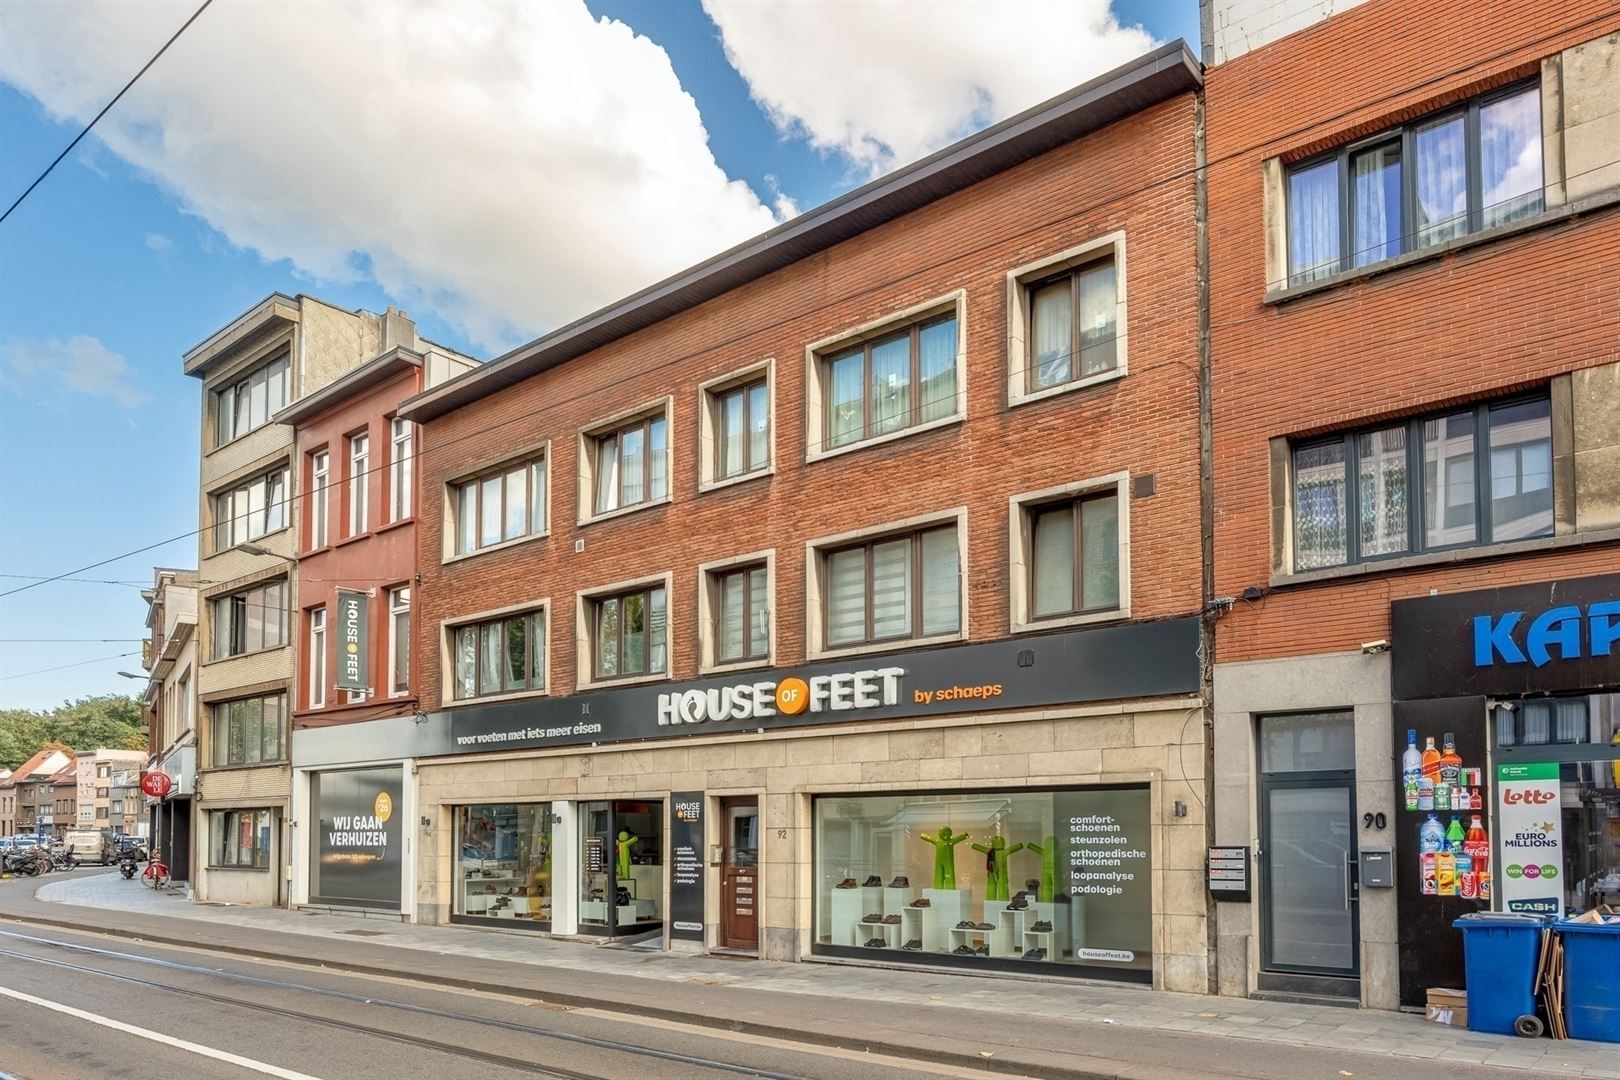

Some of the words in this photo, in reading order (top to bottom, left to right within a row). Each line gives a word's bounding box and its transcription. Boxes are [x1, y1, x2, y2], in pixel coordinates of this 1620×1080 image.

[346, 600, 359, 643] HOUSE
[346, 653, 359, 682] FEET
[658, 681, 777, 726] HOUSE
[781, 689, 798, 703] OF
[809, 667, 905, 713] FEET
[914, 689, 933, 705] by
[935, 683, 1003, 702] schaeps
[457, 734, 477, 745] voor
[477, 731, 508, 744] voeten
[508, 729, 526, 741] met
[527, 727, 546, 739] iets
[546, 726, 573, 738] meer
[573, 722, 602, 735] eisen
[1503, 788, 1556, 805] Lotto
[675, 802, 701, 811] HOUSE
[683, 810, 700, 819] FEET
[1070, 815, 1115, 824] comfort-
[333, 816, 351, 831] WIJ
[352, 815, 383, 831] GAAN
[1363, 812, 1387, 830] 90
[1070, 824, 1120, 832] schoenen
[329, 831, 387, 847] VERHUIZEN
[777, 829, 787, 839] 92
[1515, 832, 1546, 840] EURO
[1070, 835, 1127, 844] steunzolen
[1504, 840, 1558, 848] MILLIONS
[1070, 849, 1146, 859] orthopedische
[1070, 858, 1121, 866] schoenen
[1071, 871, 1134, 881] loopanalyse
[1071, 885, 1123, 895] podologie
[1511, 902, 1556, 911] CASH
[1082, 951, 1131, 960] houseoffeet.be
